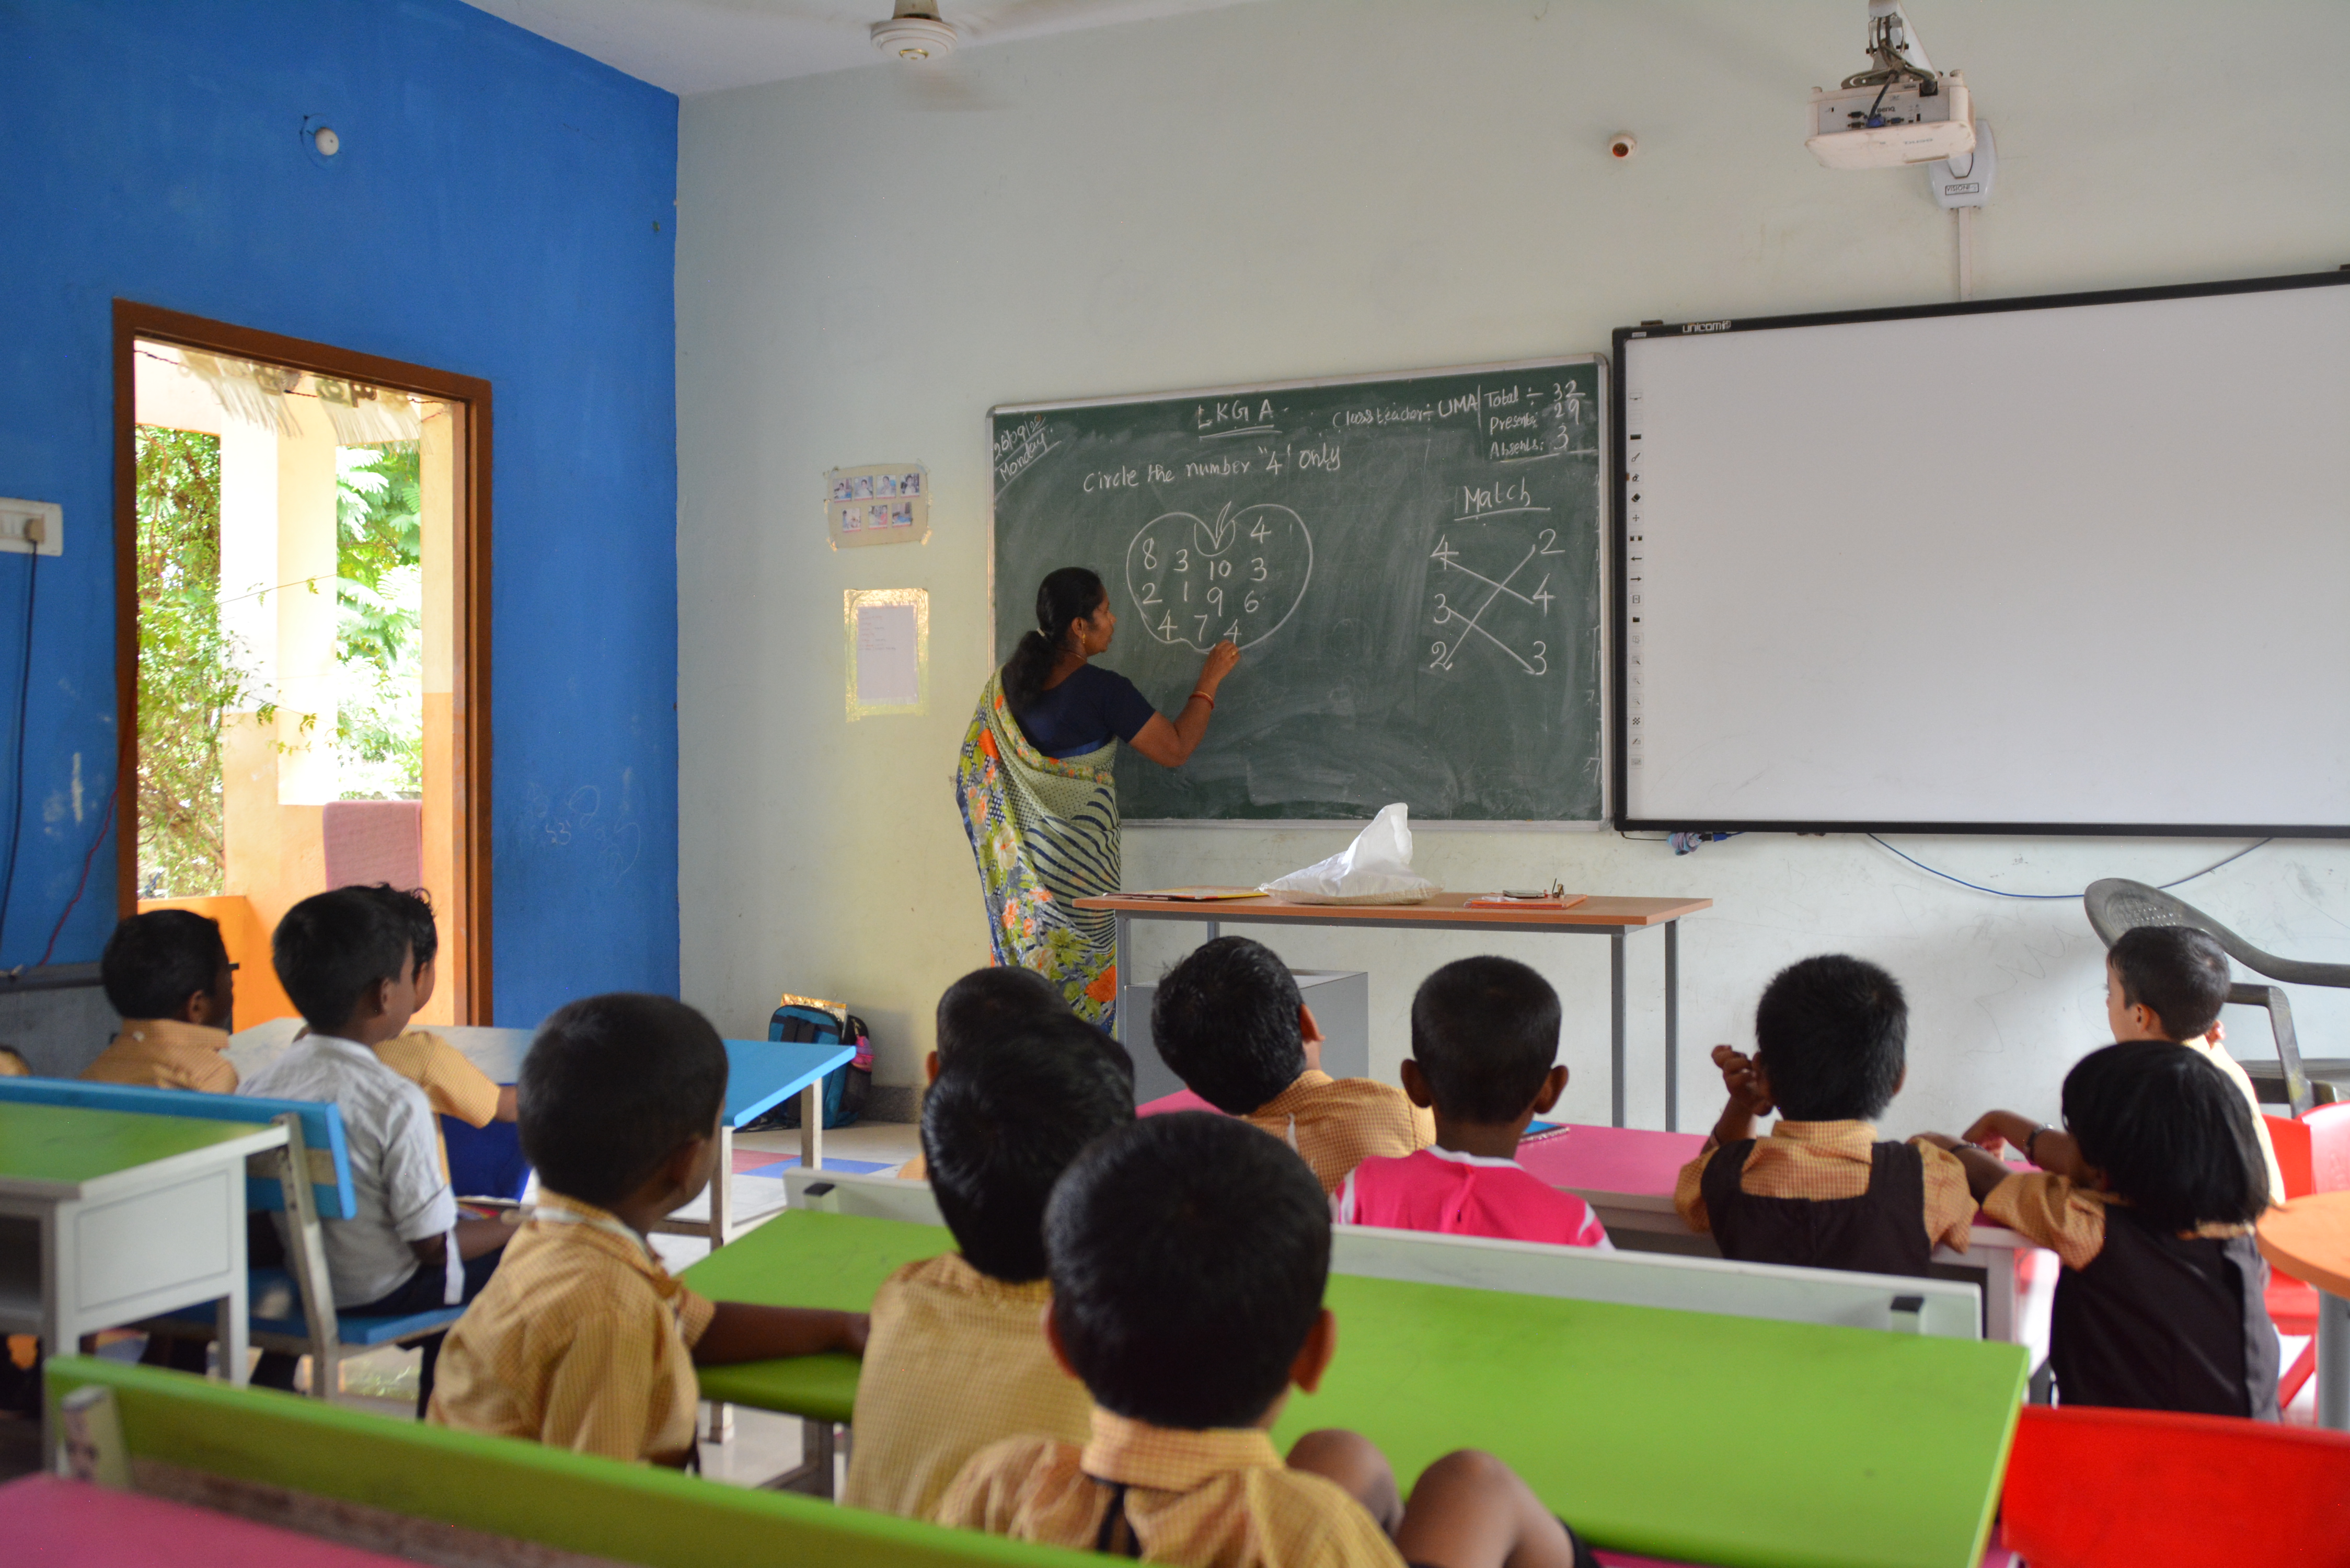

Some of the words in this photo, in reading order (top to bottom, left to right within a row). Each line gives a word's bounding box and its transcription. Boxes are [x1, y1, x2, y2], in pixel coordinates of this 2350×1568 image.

[1438, 393, 1478, 417] UMA
[1484, 385, 1518, 407] Total
[1553, 379, 1586, 402] 32
[1554, 398, 1580, 425] 29
[1553, 424, 1569, 450] 3
[999, 433, 1047, 481] Monday
[1084, 465, 1139, 492] Circle
[1147, 464, 1176, 482] the
[1185, 455, 1251, 477] number
[1464, 476, 1531, 514] Match
[1251, 515, 1272, 544] 4
[1143, 537, 1157, 569] 8
[1173, 549, 1188, 571] 3
[1210, 559, 1232, 580] 10
[1250, 557, 1268, 581] 3
[1430, 534, 1459, 570] 4
[1539, 528, 1565, 554] 2
[1142, 582, 1162, 604] 2
[1183, 581, 1188, 602] 1
[1207, 586, 1223, 617] 9
[1244, 590, 1259, 613] 6
[1433, 593, 1452, 624] 3
[1533, 573, 1557, 618] 4
[1157, 609, 1178, 640] 4
[1194, 614, 1207, 642] 7
[1224, 618, 1242, 644] 4
[1430, 641, 1453, 671] 2
[1533, 640, 1547, 675] 3
